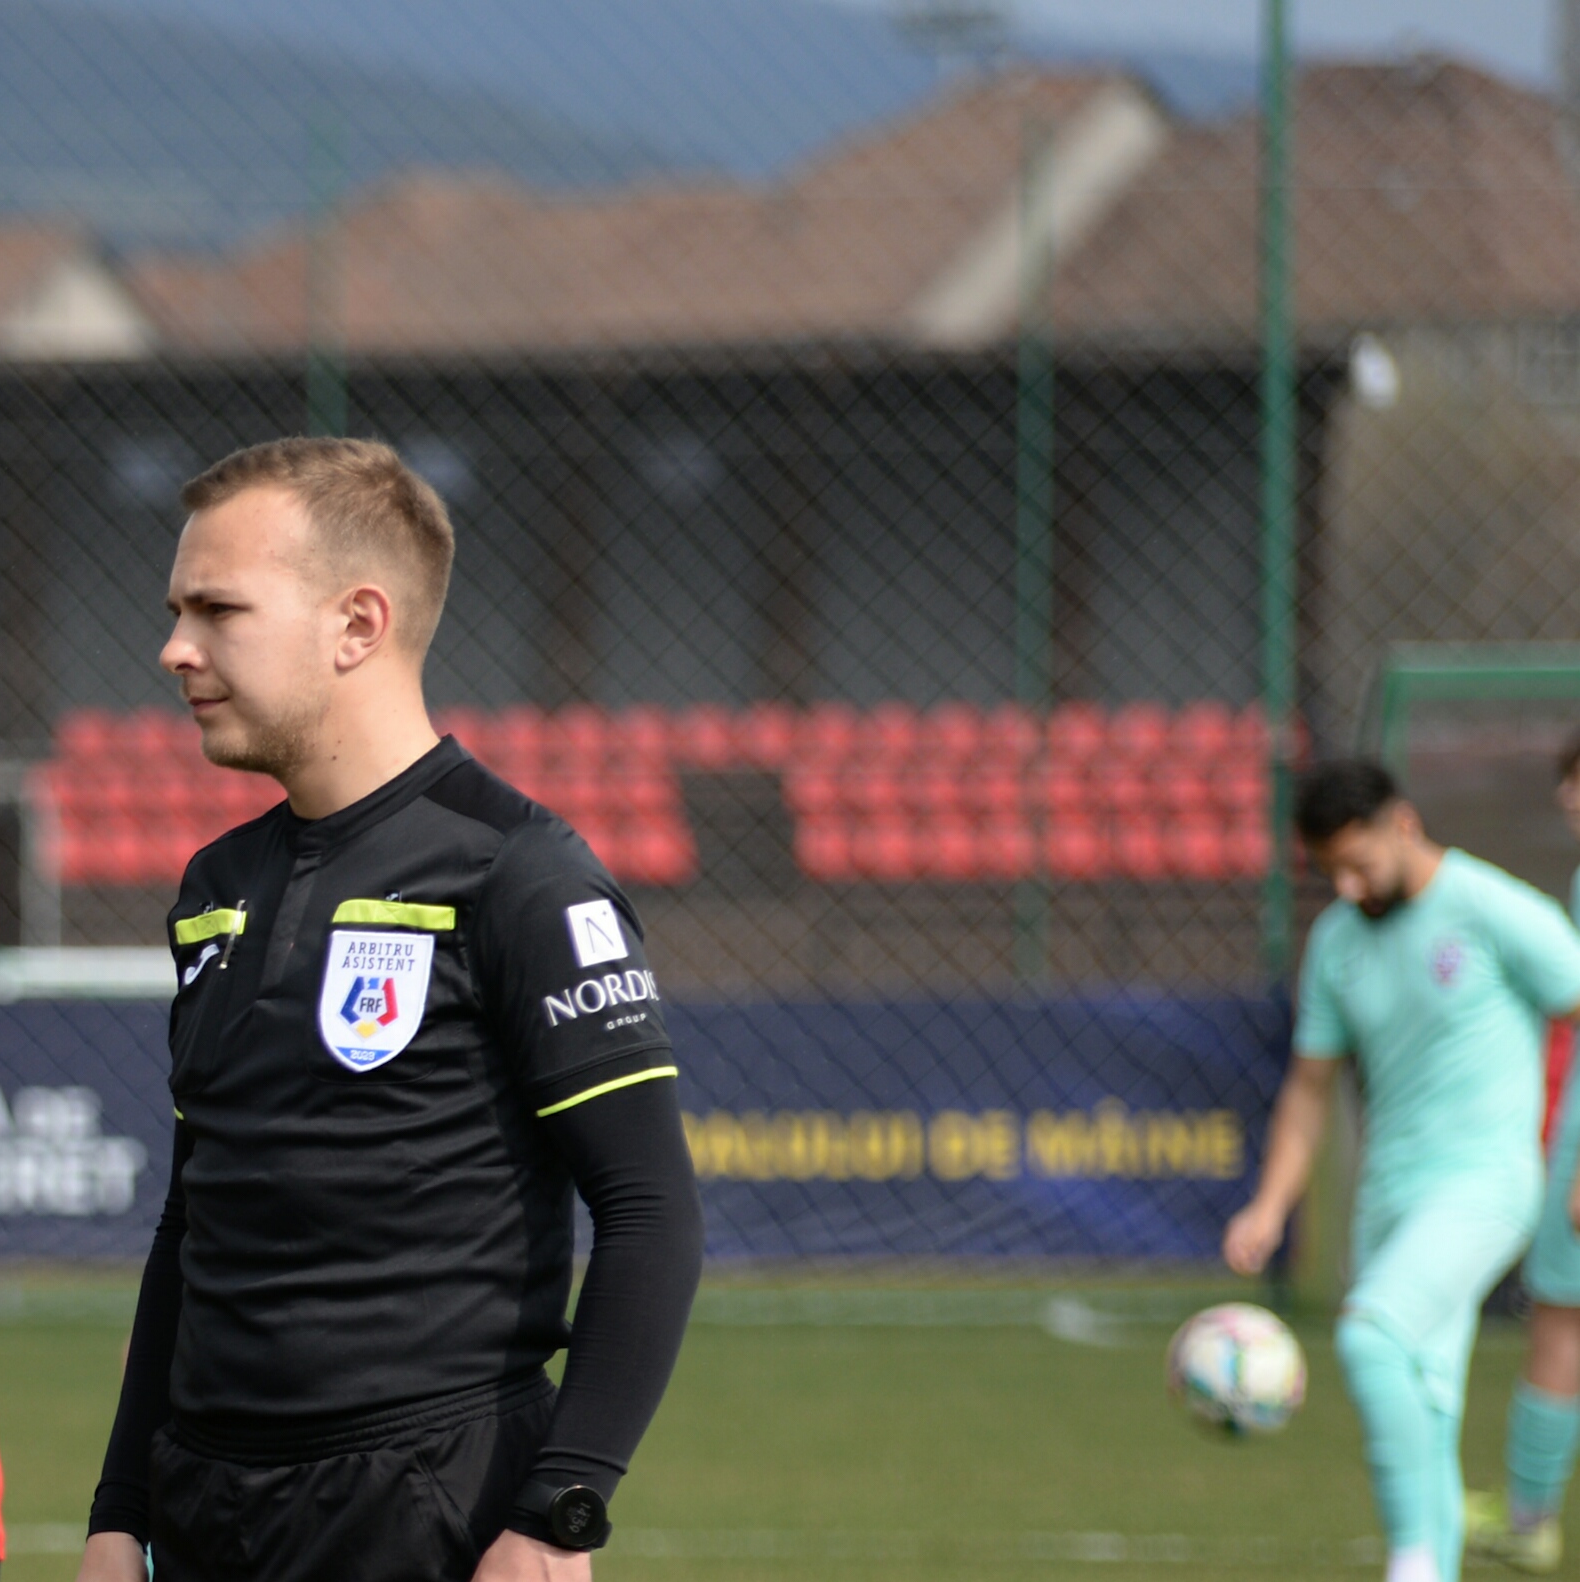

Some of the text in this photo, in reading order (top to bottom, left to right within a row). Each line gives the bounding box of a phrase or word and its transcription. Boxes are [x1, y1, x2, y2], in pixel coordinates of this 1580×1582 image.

[347, 941, 414, 957] ARBITRU
[341, 955, 416, 973] ASISTENT
[358, 996, 383, 1014] FRF
[605, 1012, 647, 1031] GROUP
